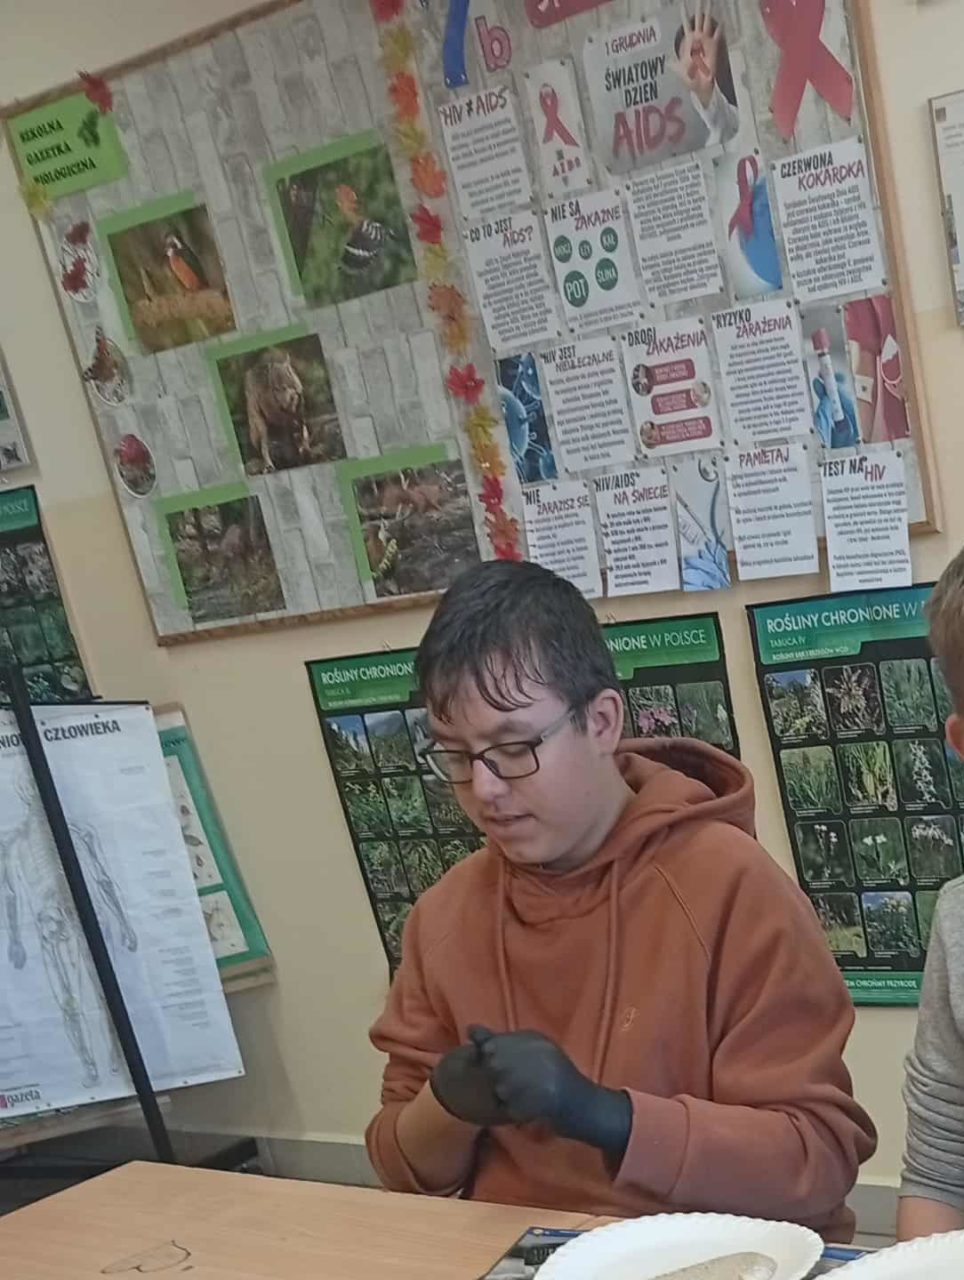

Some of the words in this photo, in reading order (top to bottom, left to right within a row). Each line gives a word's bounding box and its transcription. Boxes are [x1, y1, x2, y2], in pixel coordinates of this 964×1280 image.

[611, 26, 657, 54] GRUDNIA
[604, 55, 666, 92] ŚWIATOWY
[442, 103, 464, 127] HIV
[475, 89, 508, 117] AIDS
[612, 97, 687, 160] AIDS
[26, 141, 73, 166] GAZETKA
[780, 151, 834, 178] CZERWONA
[798, 159, 865, 191] KOKARDKA
[551, 204, 568, 222] NIE
[470, 228, 481, 242] CO
[482, 224, 492, 239] TO
[494, 217, 513, 234] JEST
[503, 225, 533, 248] AIDS?
[566, 280, 588, 299] POT
[716, 308, 752, 329] RYZYKO
[627, 327, 656, 347] DROGI
[558, 345, 576, 360] JEST
[823, 459, 847, 478] TEST
[849, 457, 864, 474] NA
[864, 464, 886, 482] HIV
[595, 472, 636, 492] HIV/AIDS
[525, 489, 541, 505] NIE
[614, 492, 630, 506] NA
[766, 613, 819, 634] ROŚLINY
[821, 603, 900, 627] CHRONIONE
[902, 602, 918, 617] W
[649, 634, 662, 647] W
[665, 629, 706, 646] POLSCE
[321, 667, 358, 685] ROŚLINY
[360, 661, 415, 680] CHRONION
[43, 719, 121, 742] CZŁOWIEKA
